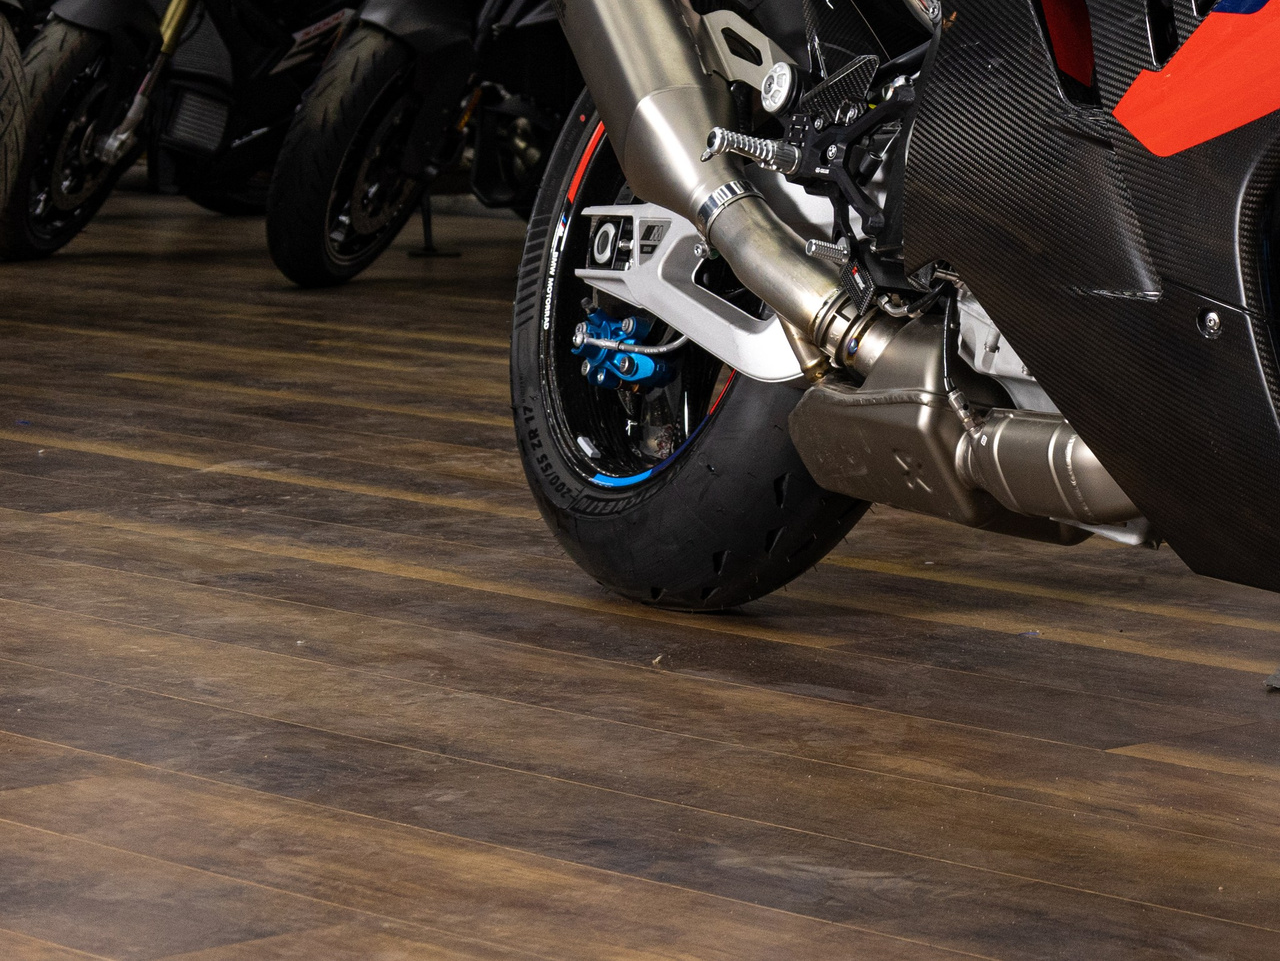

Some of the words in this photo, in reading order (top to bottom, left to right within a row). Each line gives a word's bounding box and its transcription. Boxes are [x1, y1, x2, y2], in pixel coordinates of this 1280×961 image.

[549, 250, 559, 276] BMW
[543, 277, 553, 330] MOTORRAD
[522, 405, 535, 423] 17
[528, 427, 543, 451] ZR
[535, 453, 569, 498] 200/55
